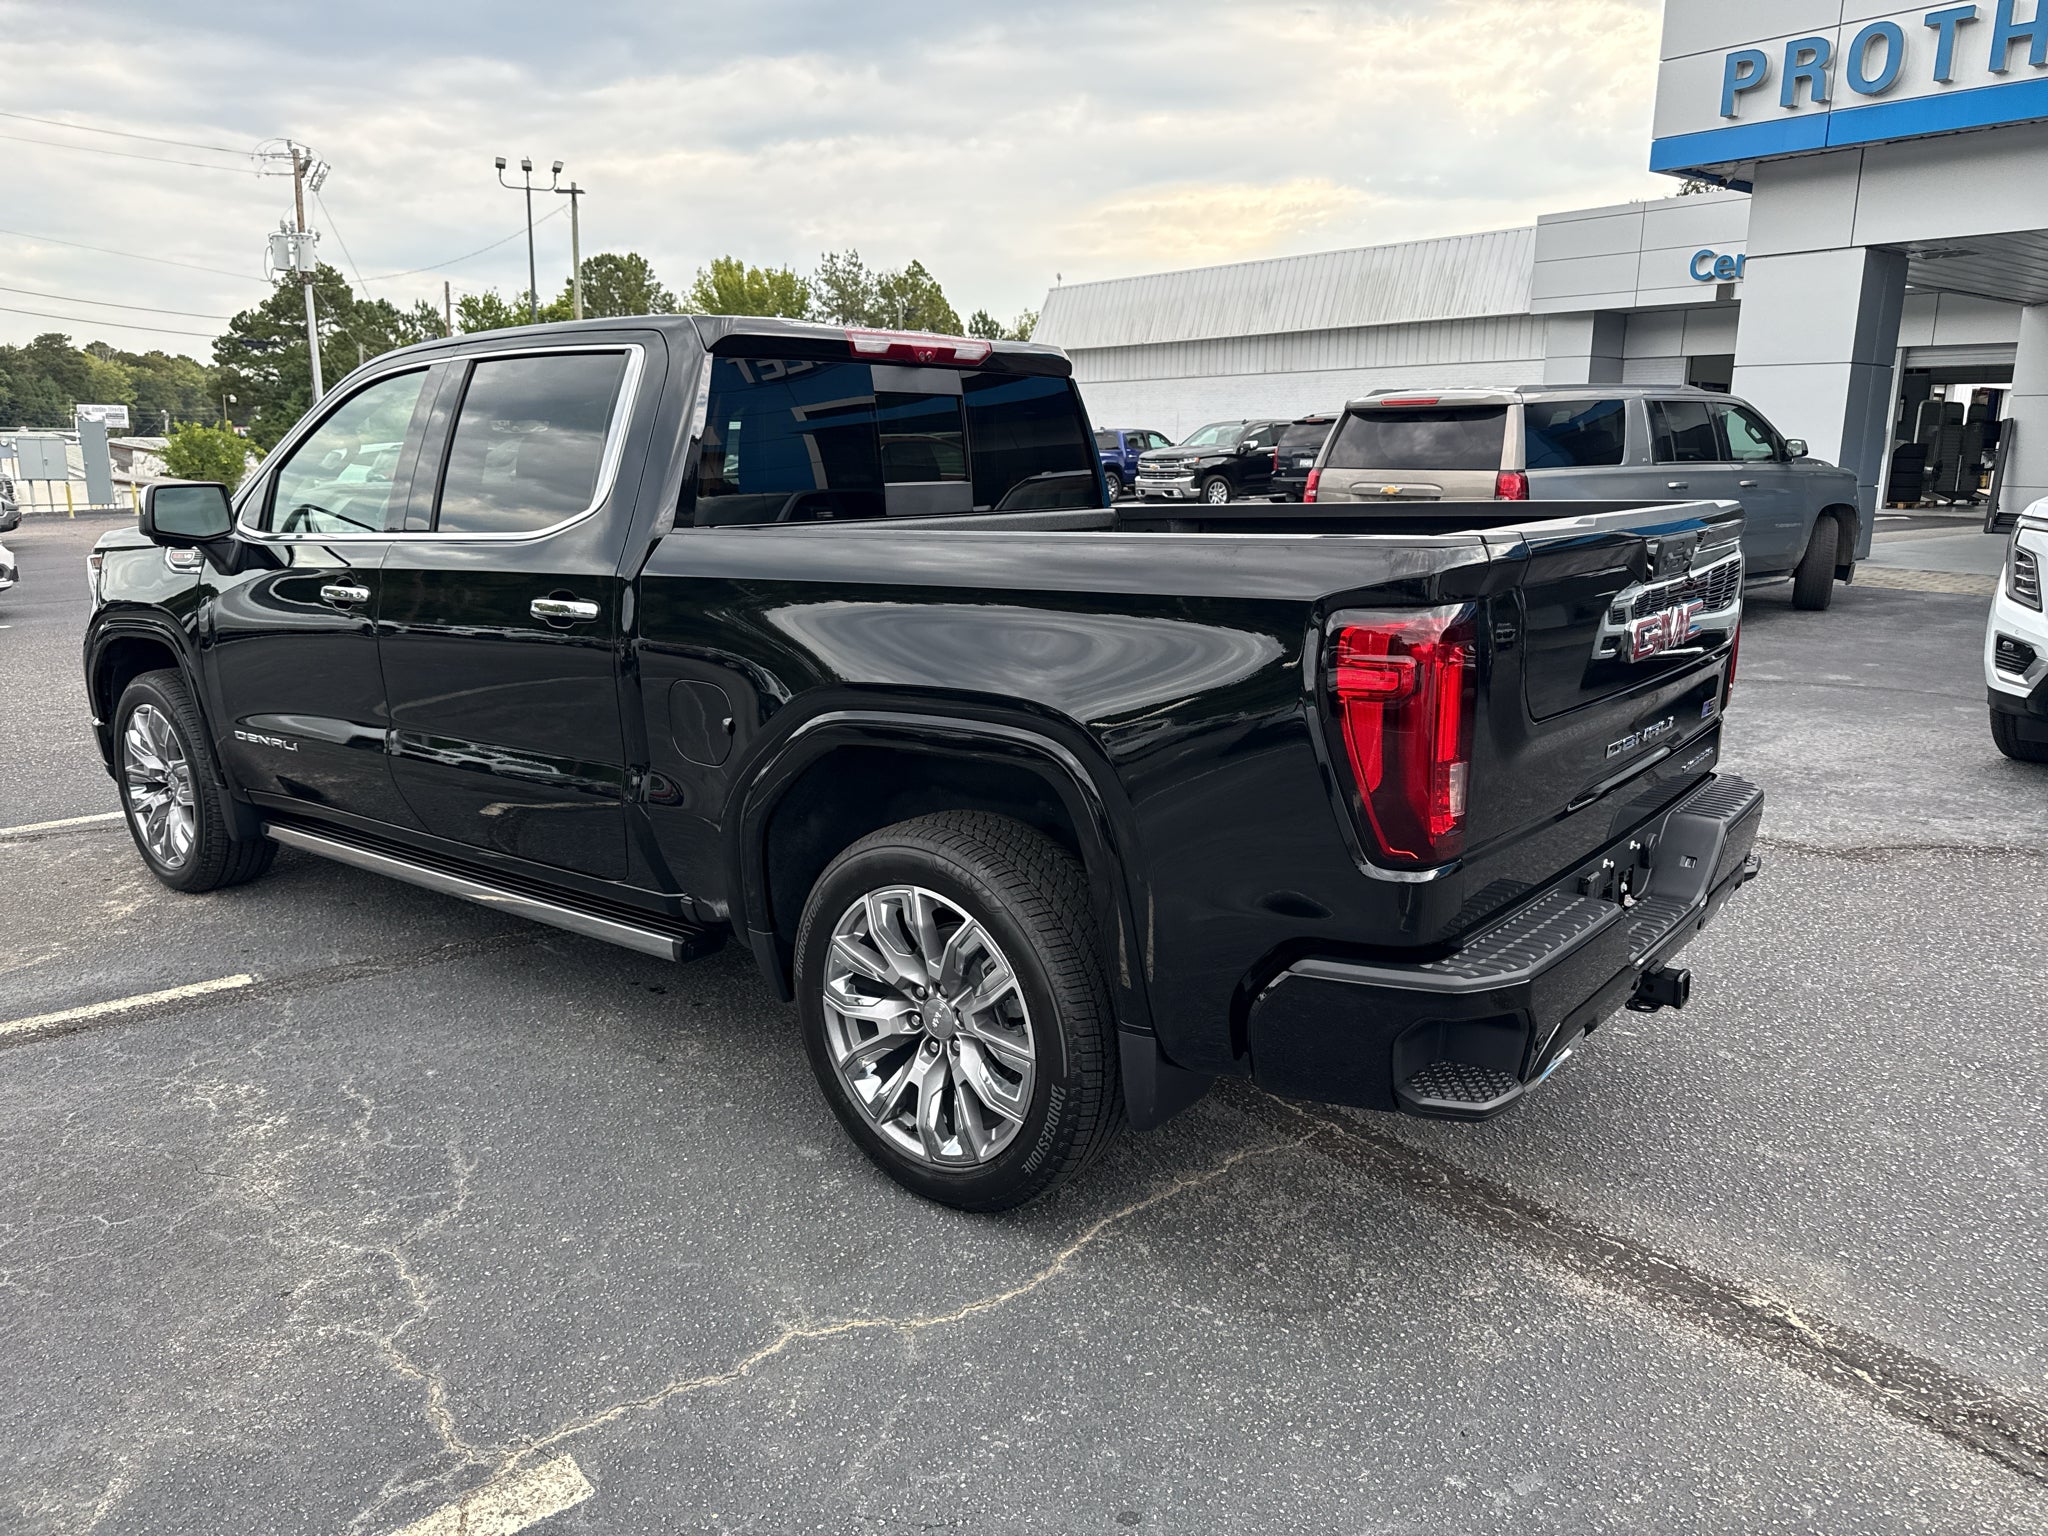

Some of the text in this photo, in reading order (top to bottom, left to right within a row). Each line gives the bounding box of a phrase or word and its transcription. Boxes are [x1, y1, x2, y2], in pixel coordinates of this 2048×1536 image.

[1631, 599, 1703, 660] GMC
[233, 730, 299, 752] DENALI
[1021, 1083, 1066, 1176] BRIDGESTONE
